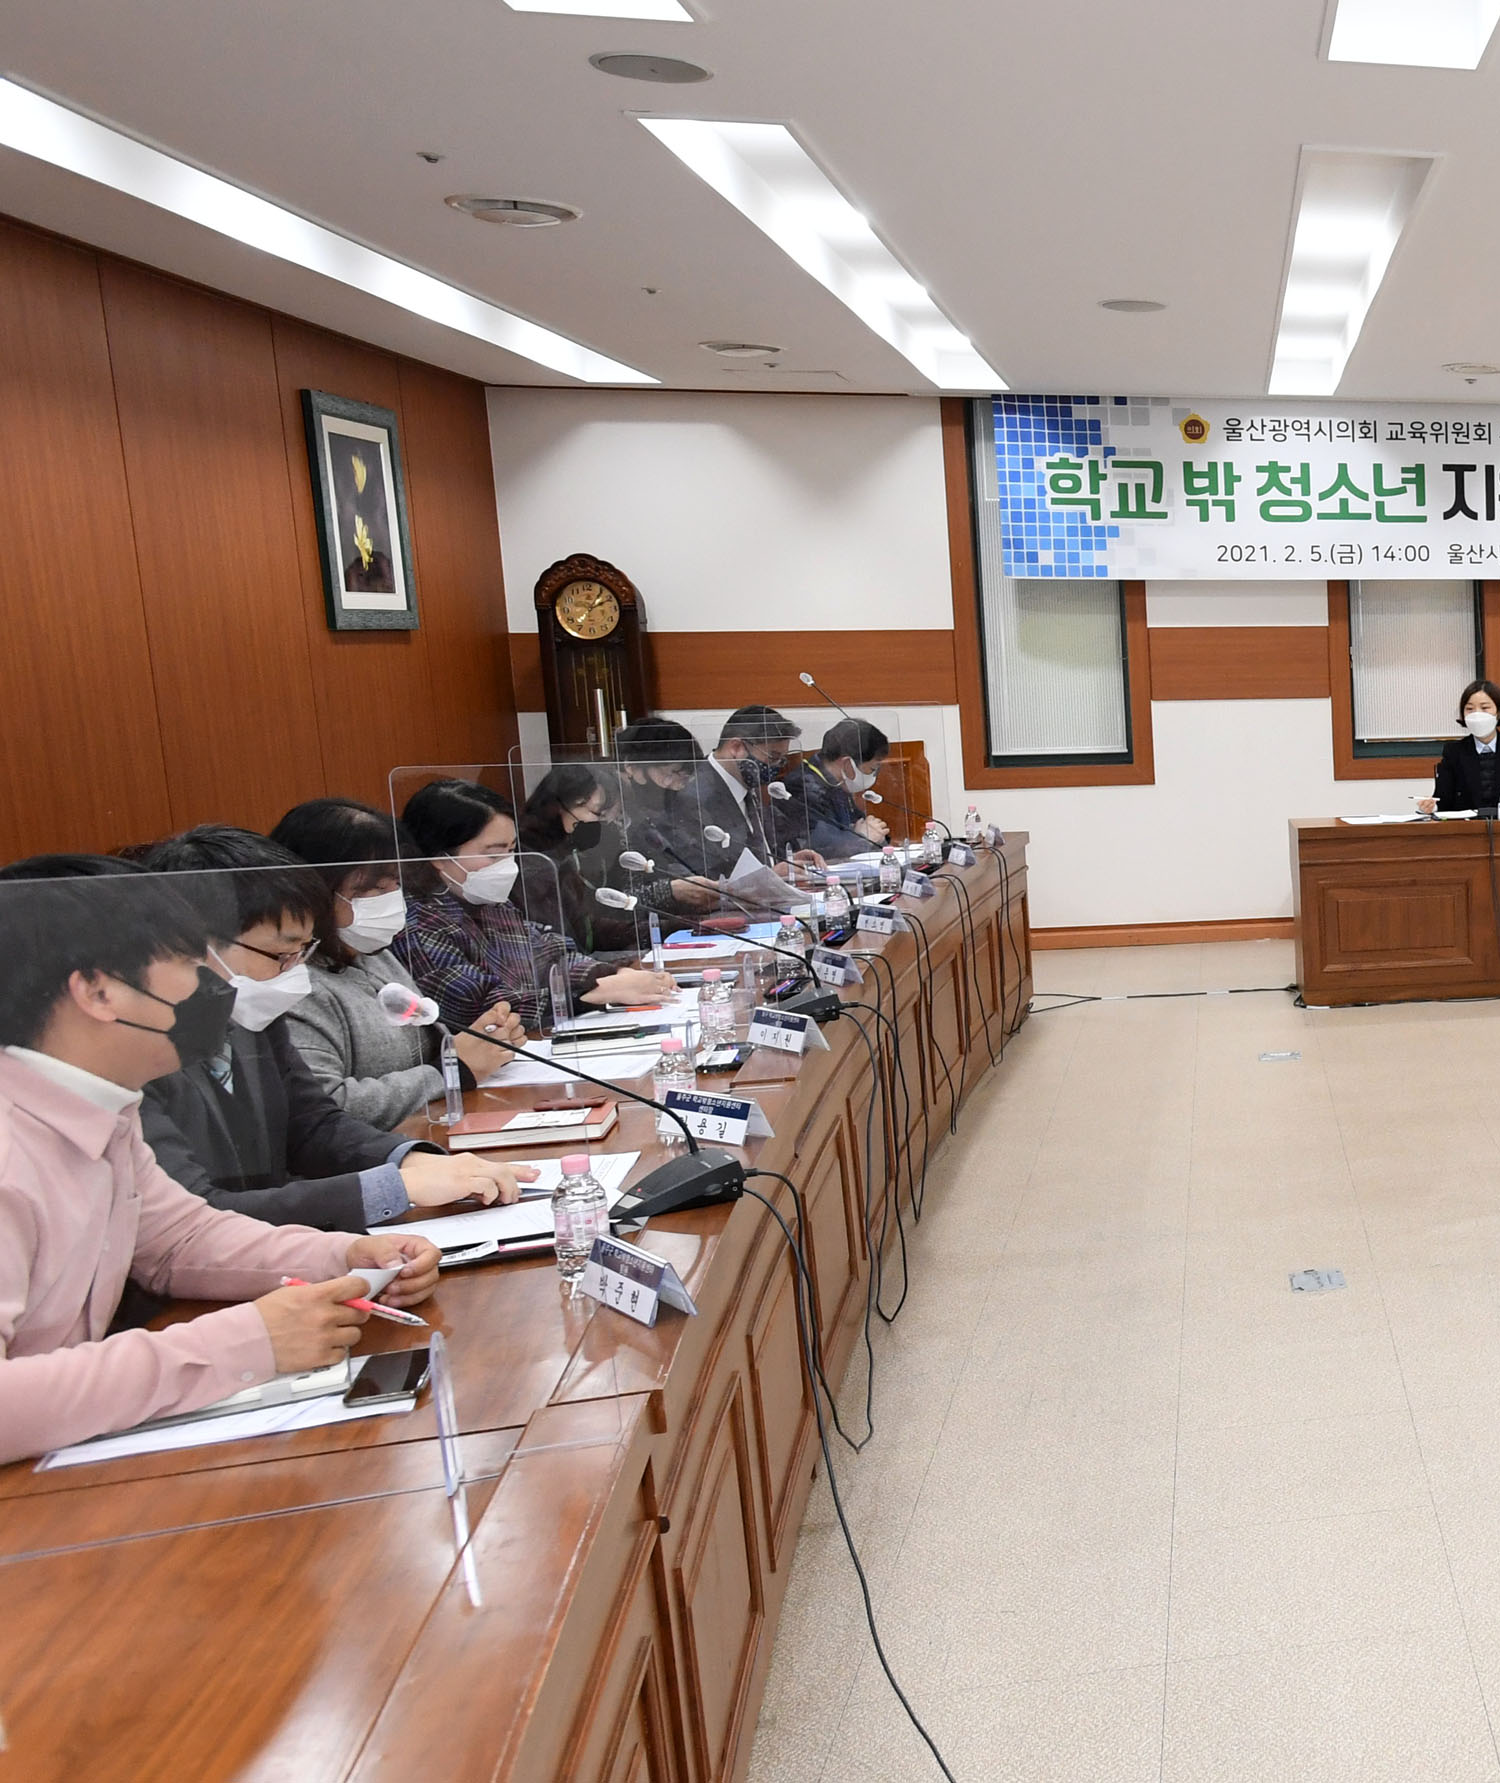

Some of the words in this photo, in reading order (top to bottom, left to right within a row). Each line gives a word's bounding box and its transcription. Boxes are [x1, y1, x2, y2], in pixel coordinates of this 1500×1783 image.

[1222, 417, 1378, 444] 울산광역시의회
[1385, 420, 1492, 446] 교육위원회
[1045, 457, 1168, 521] 학교
[1182, 461, 1242, 522] 밖
[1255, 461, 1428, 523] 청소년
[1217, 544, 1276, 563] 2021.
[1310, 544, 1364, 566] 5.(금)
[1371, 545, 1431, 563] 14:00
